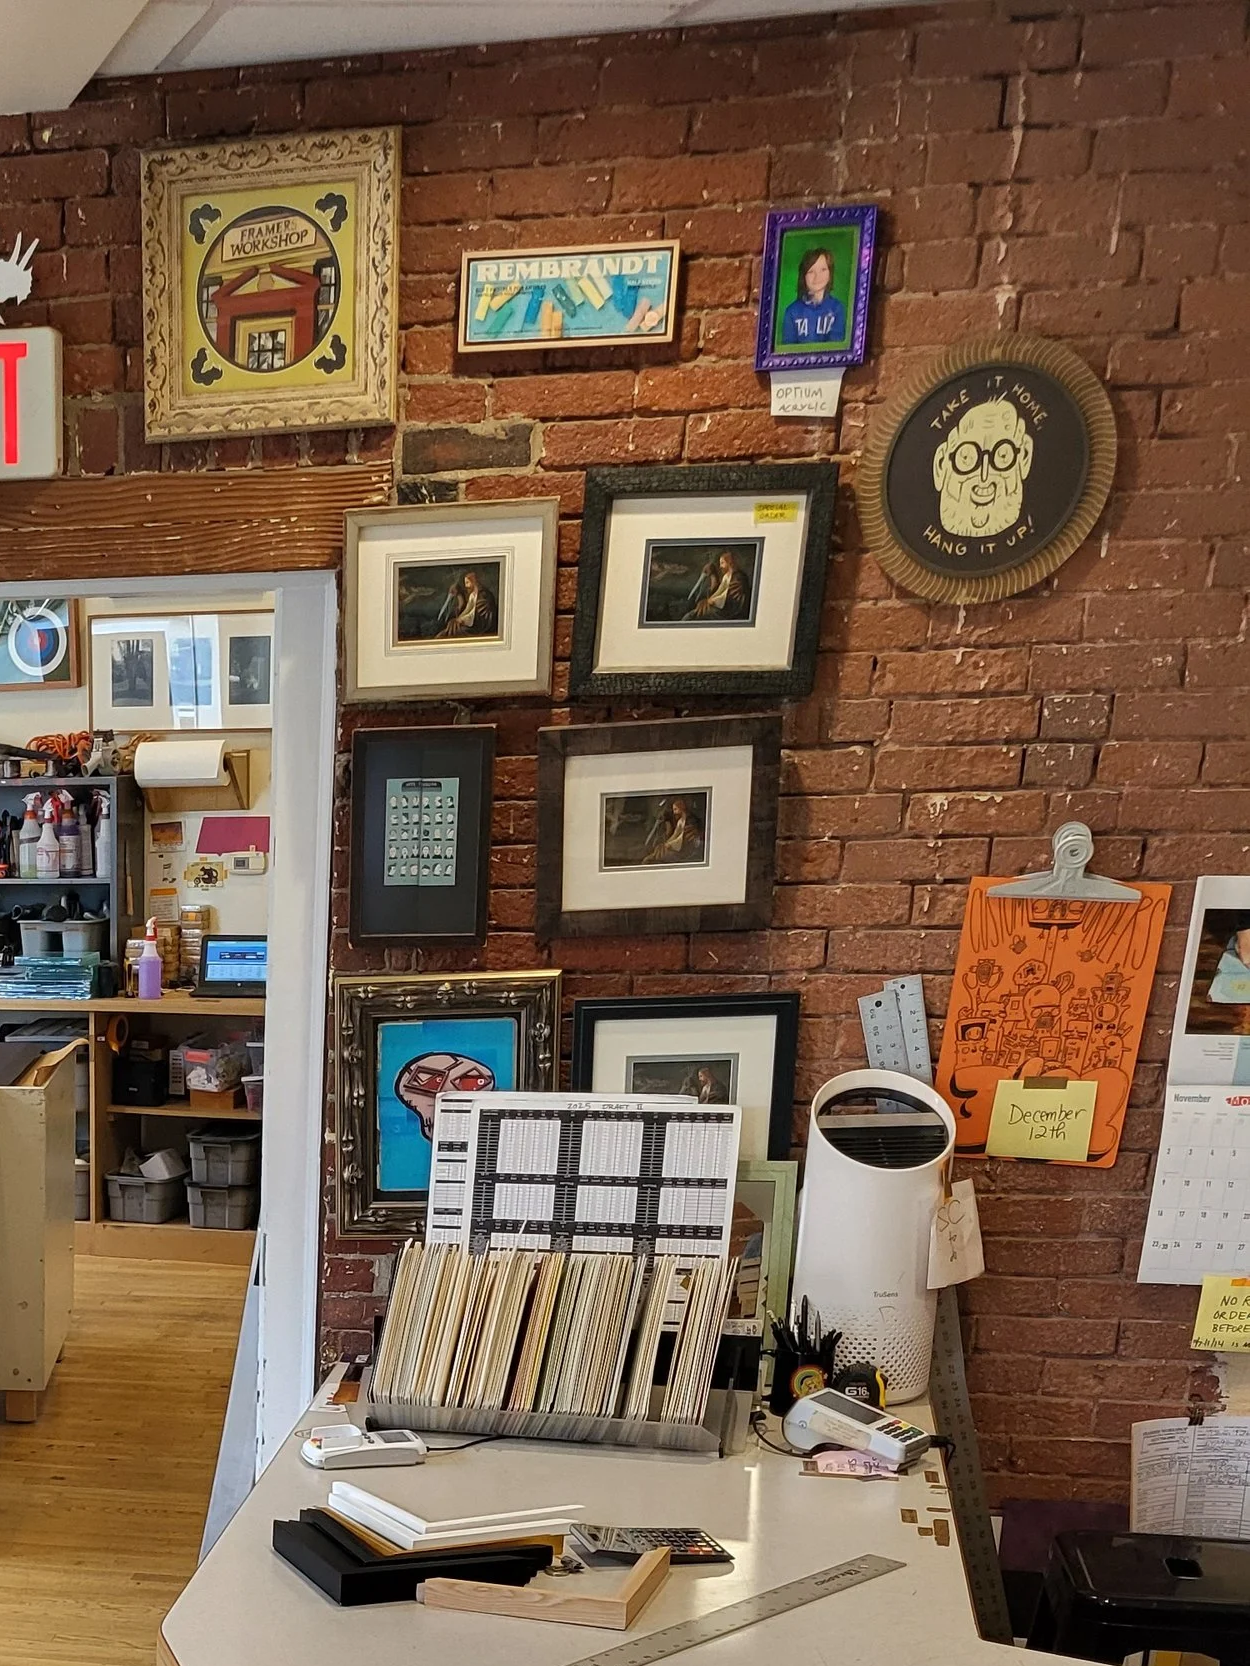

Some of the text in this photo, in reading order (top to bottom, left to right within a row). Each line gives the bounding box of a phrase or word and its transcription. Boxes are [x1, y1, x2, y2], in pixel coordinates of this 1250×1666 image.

[231, 229, 308, 257] WORKSHOP
[476, 255, 663, 282] REMBRANDT
[776, 387, 822, 399] OPTIUM
[778, 402, 827, 413] ACRYLIC
[929, 375, 1049, 431] TAKE IT HOME,
[923, 514, 1036, 556] HANG IT UP!
[1174, 1093, 1211, 1103] November
[567, 1102, 592, 1111] 2025
[602, 1103, 629, 1111] DRAFT
[1009, 1104, 1087, 1126] December
[1028, 1121, 1067, 1141] 12th
[1238, 1243, 1246, 1251] 27
[872, 1290, 899, 1299] TruSens
[1220, 1295, 1238, 1307] NO
